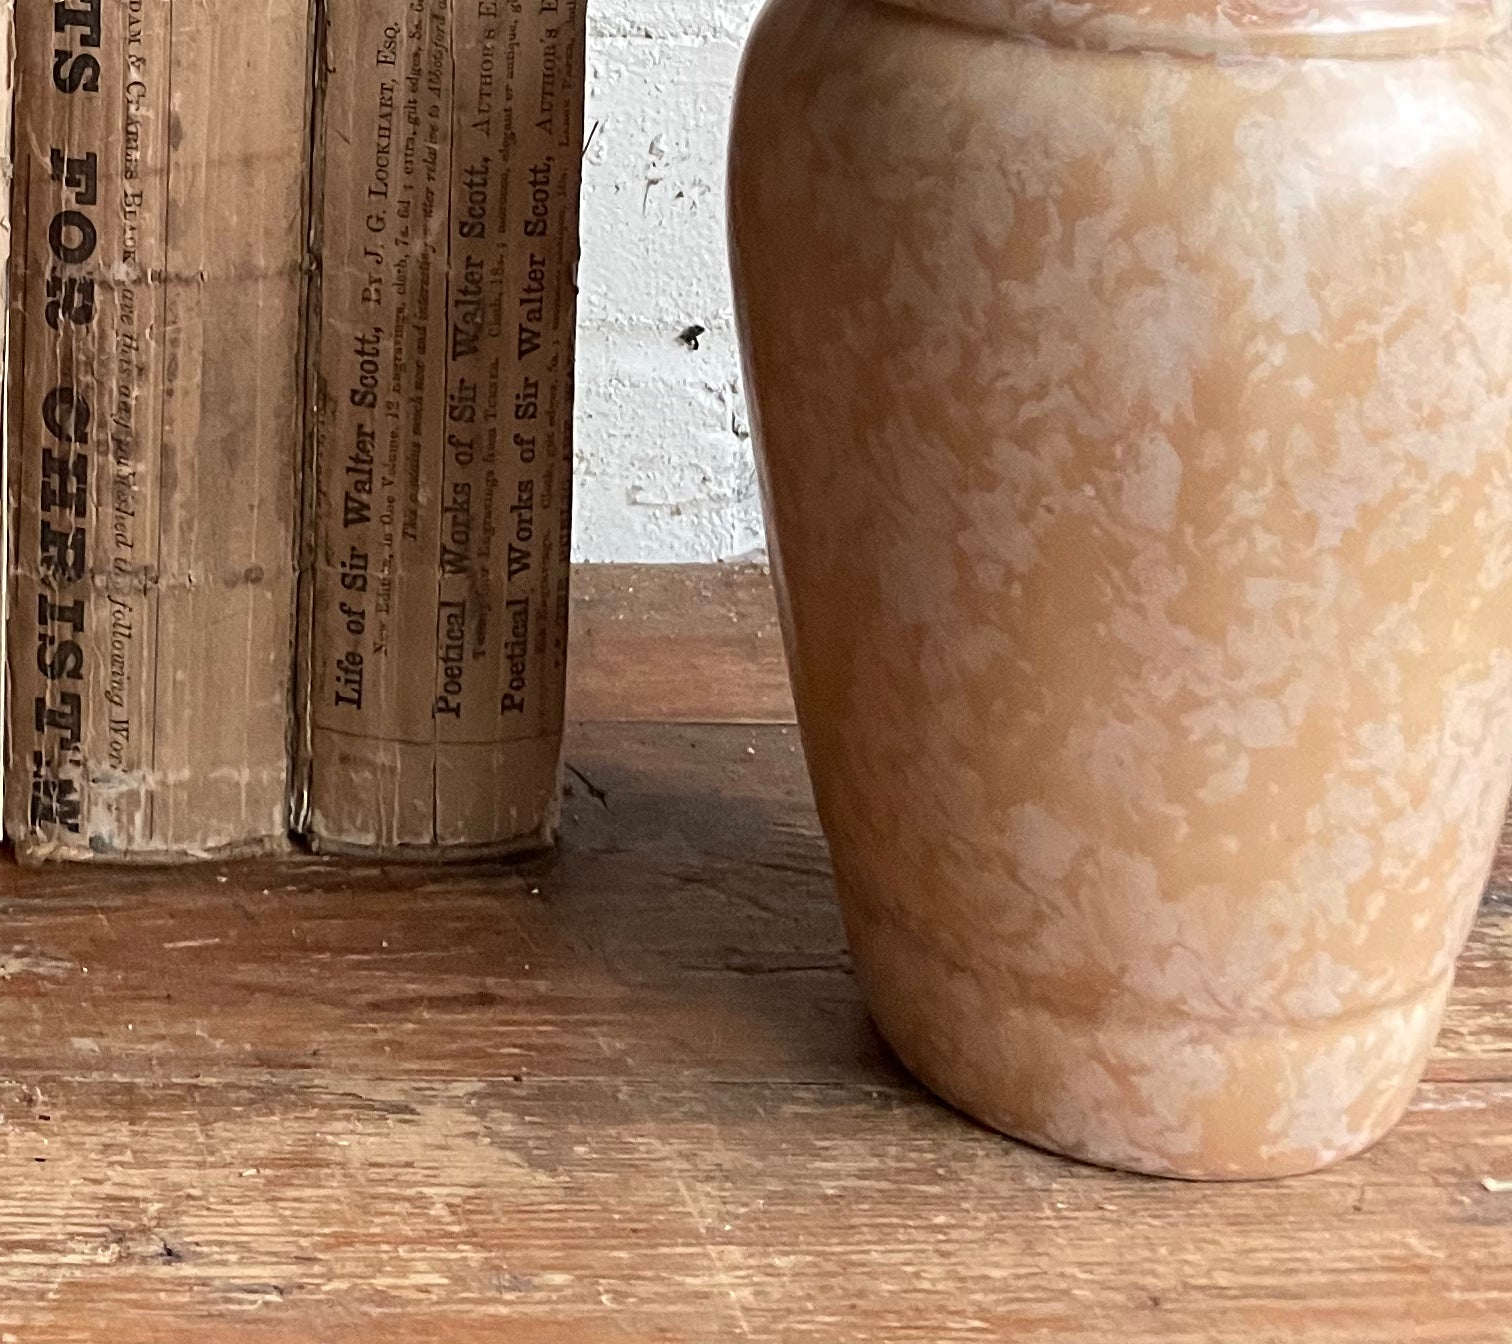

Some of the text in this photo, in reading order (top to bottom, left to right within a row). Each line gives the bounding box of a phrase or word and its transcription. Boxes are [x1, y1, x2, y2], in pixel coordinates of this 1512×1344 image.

[367, 78, 399, 200] LOCKHART,
[44, 147, 99, 331] FOR
[365, 209, 387, 233] G.
[458, 155, 493, 240] Scott,
[523, 155, 555, 238] Scott,
[451, 254, 485, 362] Walter
[517, 252, 546, 361] Walter
[349, 326, 385, 409] Scott,
[448, 376, 477, 424] Sir
[513, 376, 539, 421] Sir
[342, 423, 376, 529] Walter
[447, 433, 474, 467] of
[512, 432, 536, 464] of
[339, 545, 369, 593] Sir
[439, 481, 471, 577] Works
[507, 478, 534, 582] Works
[105, 594, 133, 708] following
[338, 601, 366, 636] of
[431, 598, 466, 719] Poetical
[500, 595, 529, 716] Poetical
[334, 650, 364, 711] Life
